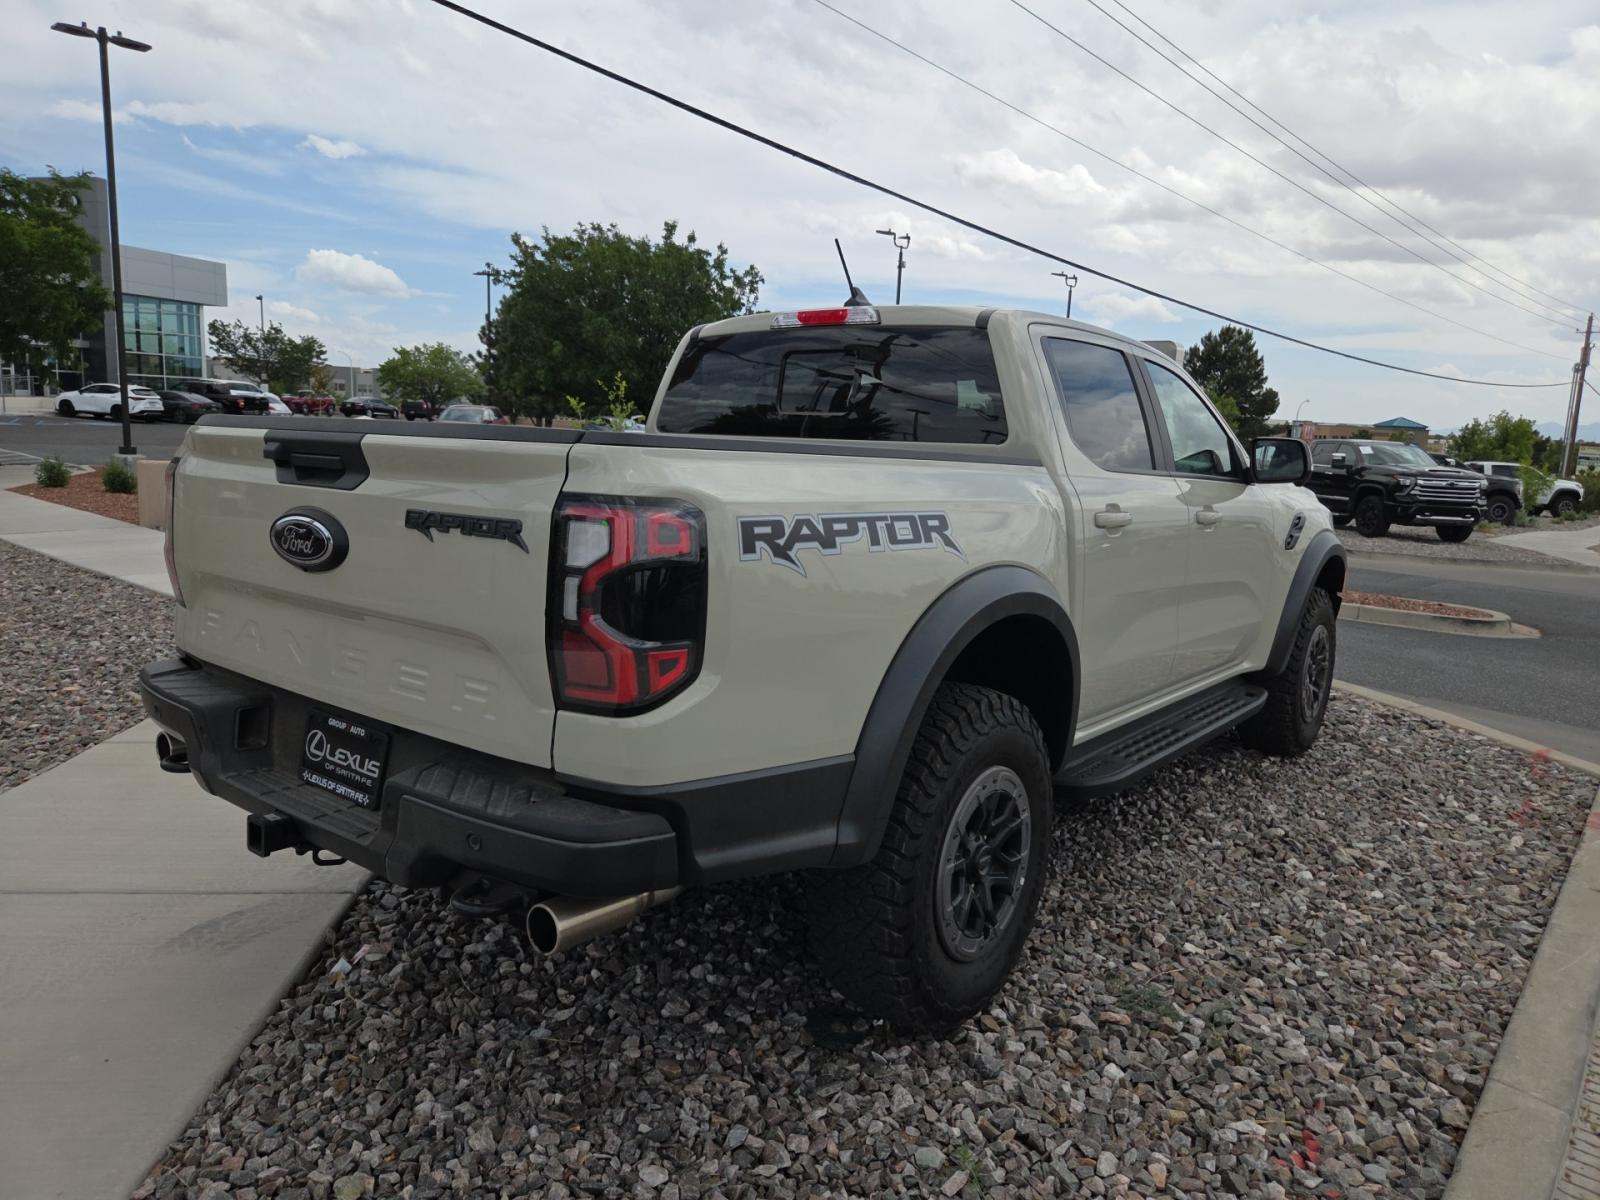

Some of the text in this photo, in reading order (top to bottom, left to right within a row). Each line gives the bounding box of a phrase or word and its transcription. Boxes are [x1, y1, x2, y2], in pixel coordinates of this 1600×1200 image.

[281, 525, 314, 555] Ford
[404, 508, 530, 554] RAPTOR
[736, 510, 969, 577] RAPTOR
[200, 610, 497, 721] RANGER
[328, 718, 347, 729] GROUP
[350, 725, 365, 736] AUTO
[325, 762, 373, 787] OF SANTA FE
[326, 743, 380, 778] LEXUS
[308, 773, 364, 803] LEXUS OF SANTA FE
